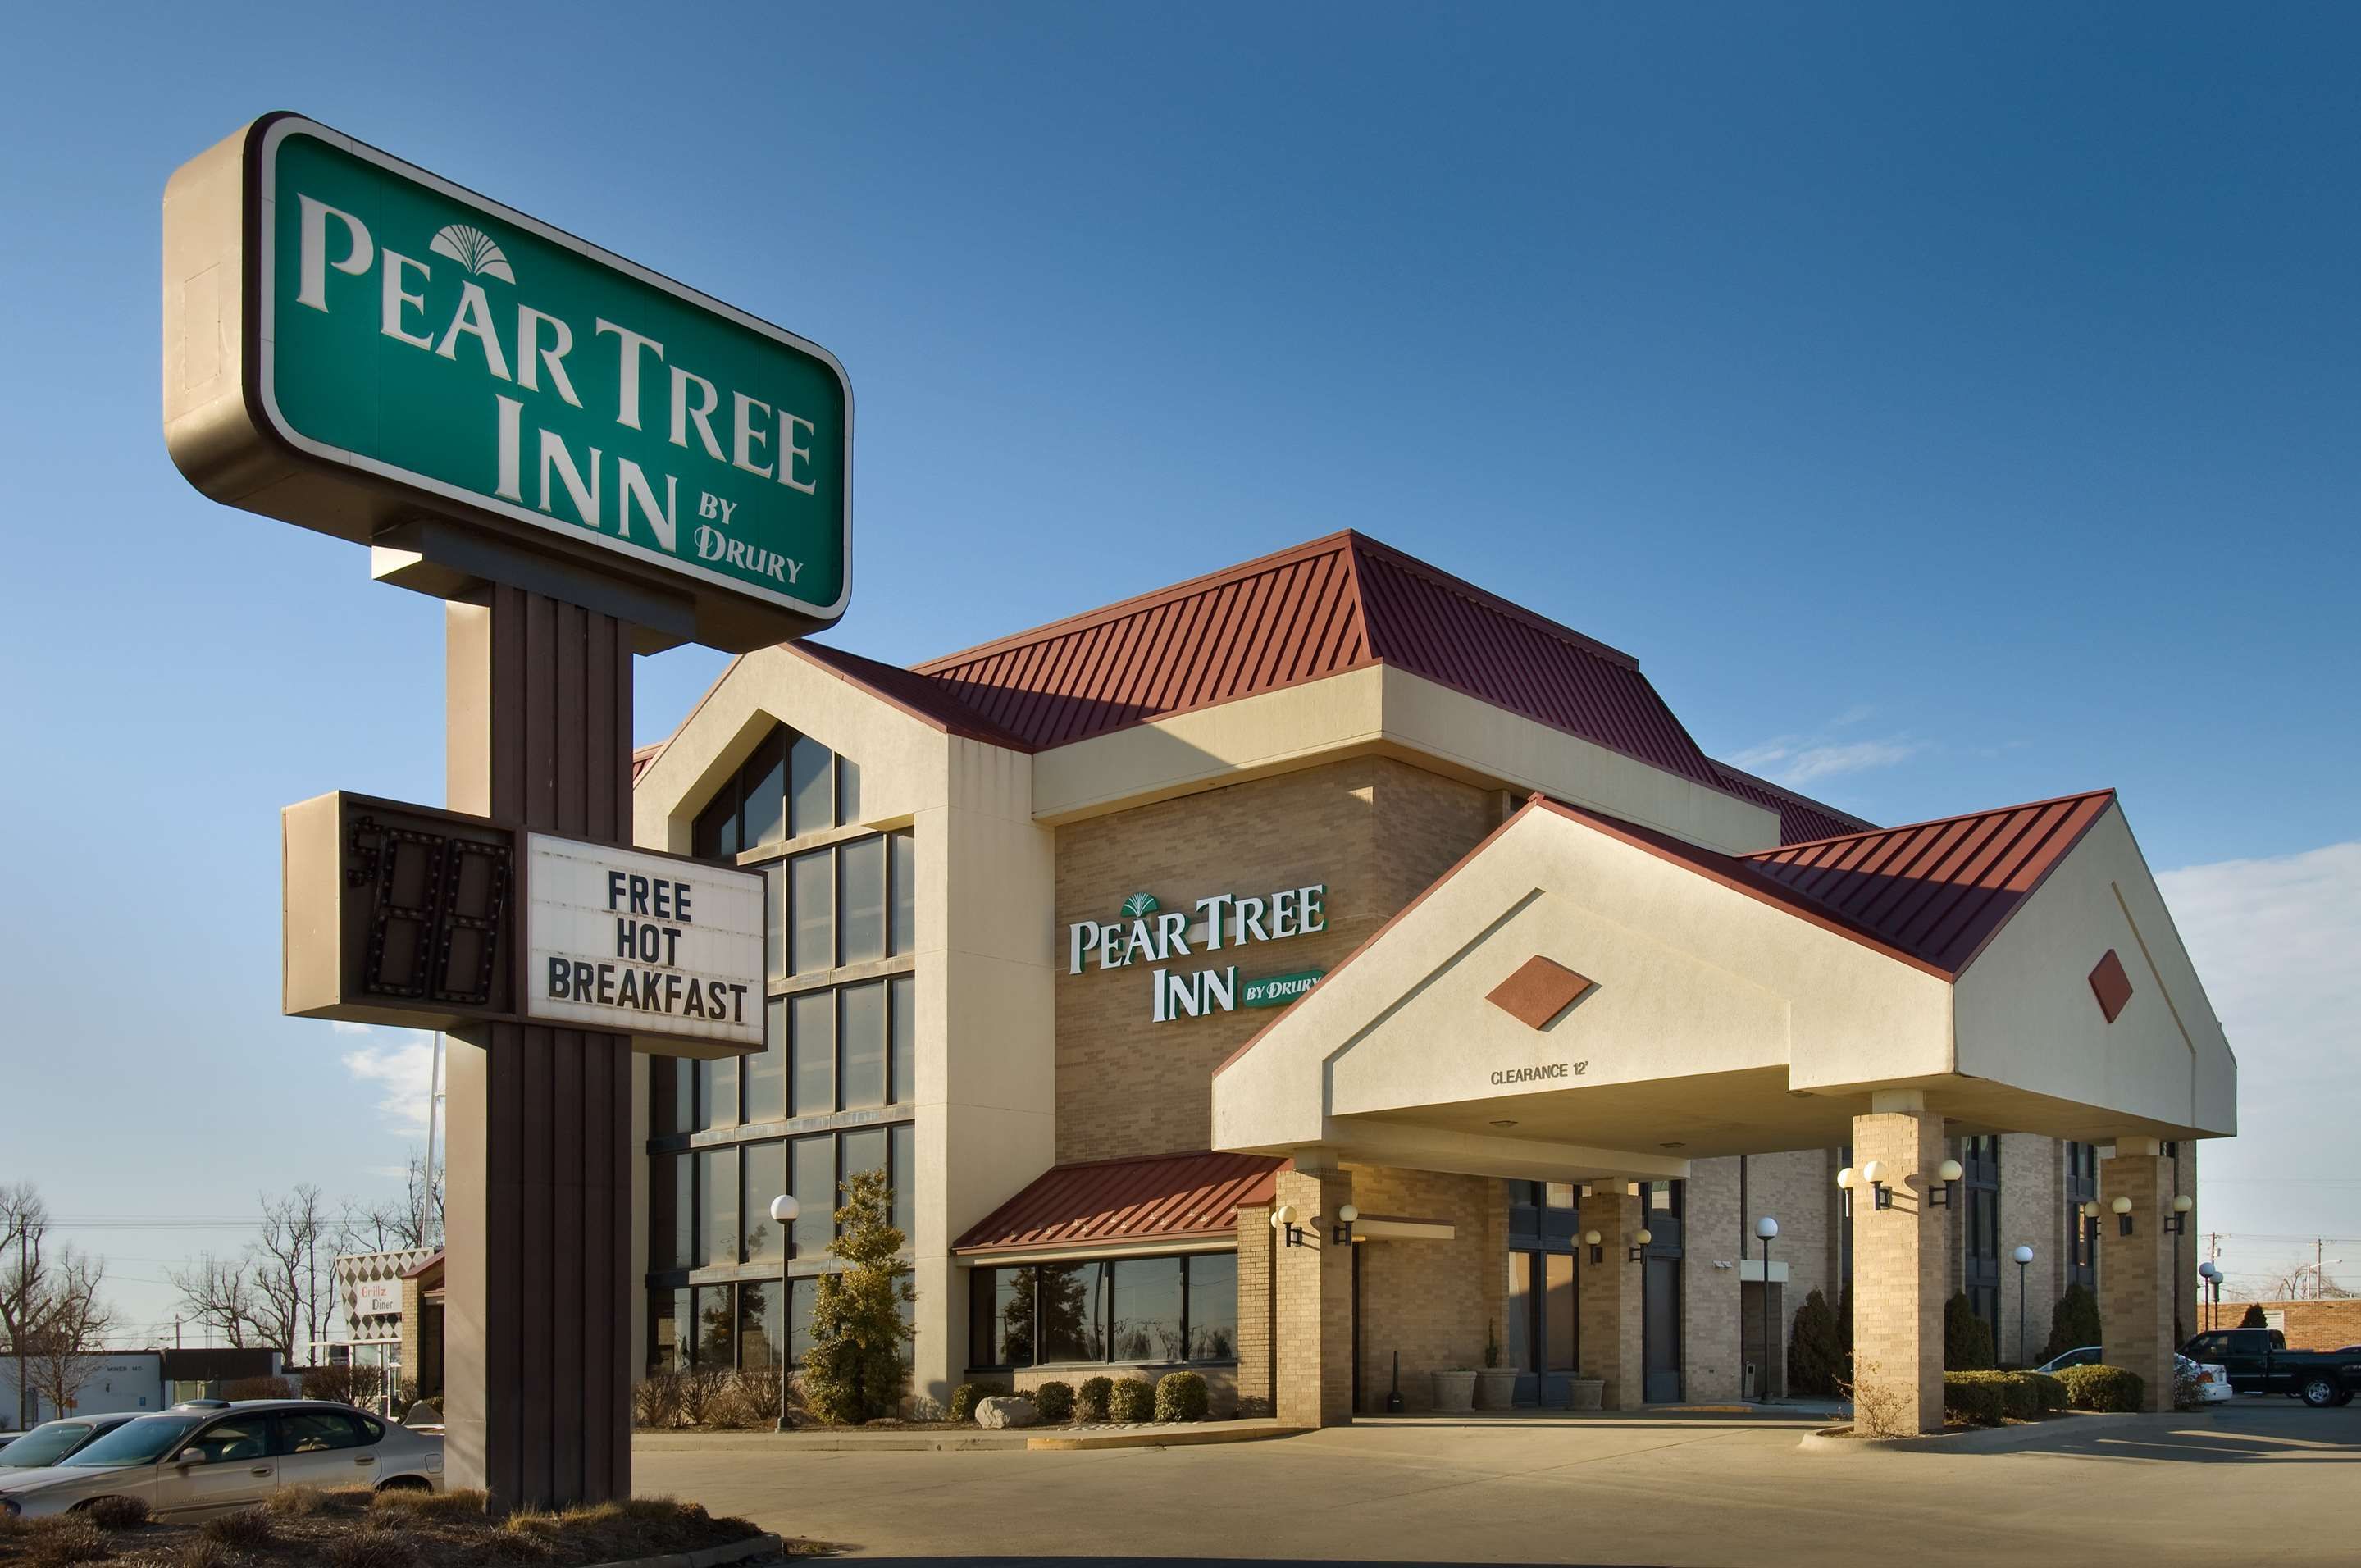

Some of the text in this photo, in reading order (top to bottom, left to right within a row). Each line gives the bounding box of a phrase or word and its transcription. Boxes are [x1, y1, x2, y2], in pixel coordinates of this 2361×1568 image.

[296, 192, 817, 495] PEAR TREE
[495, 394, 678, 553] INN
[699, 491, 737, 525] BY
[694, 524, 804, 585] DRURY
[608, 870, 691, 923] FREE
[617, 918, 681, 967] HOT
[1069, 883, 1327, 975] PEAR TREE
[549, 956, 748, 1023] BREAKFAST
[1152, 965, 1238, 1023] INN
[1246, 985, 1265, 1001] BY
[1491, 1064, 1568, 1085] CLEARANCE
[361, 1285, 386, 1298] Grillz
[372, 1298, 394, 1310] Diner
